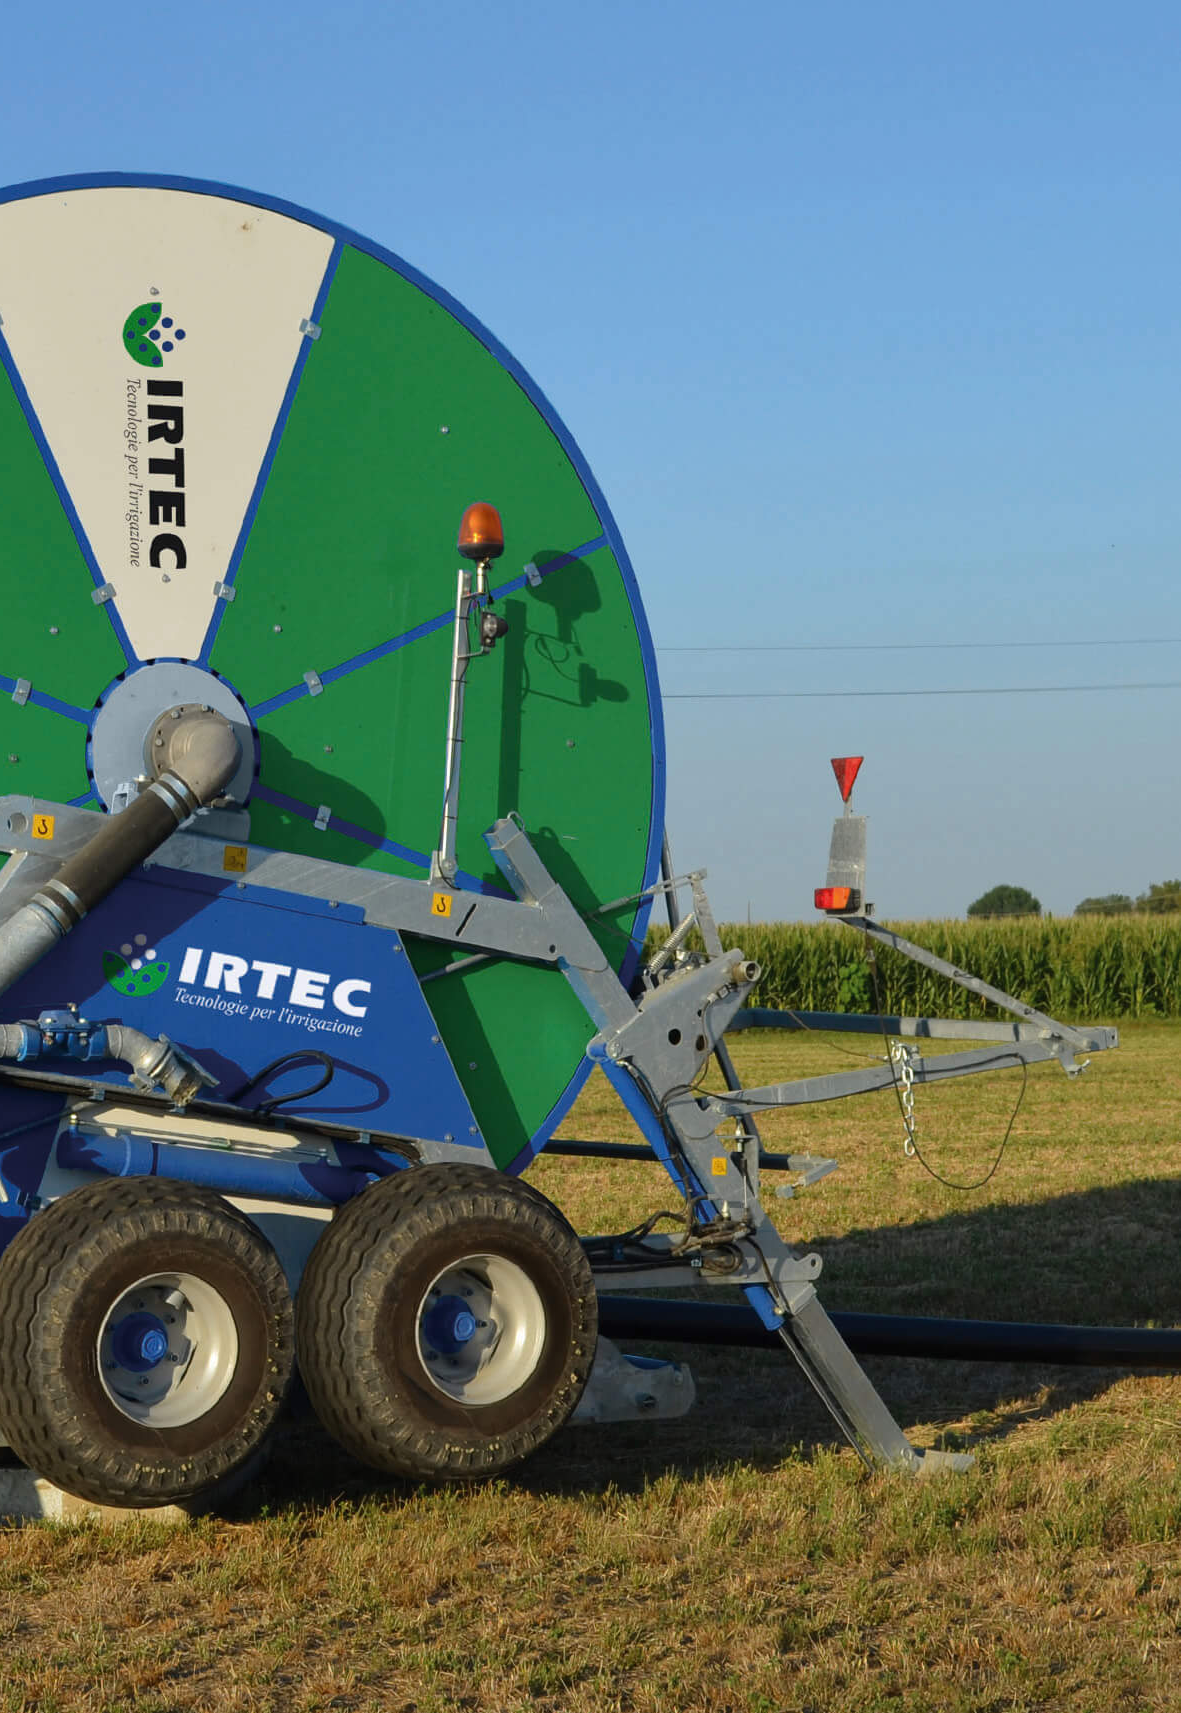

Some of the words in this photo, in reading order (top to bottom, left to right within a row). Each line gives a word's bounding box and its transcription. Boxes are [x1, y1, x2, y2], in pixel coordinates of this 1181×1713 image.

[124, 378, 141, 452] Tecnologie
[124, 453, 139, 480] per
[146, 379, 187, 570] IRTEC
[125, 483, 144, 568] l'irrigazione
[174, 986, 249, 1017] Tecnologie
[249, 1006, 276, 1021] per
[277, 1007, 363, 1037] l'irrigazione
[178, 946, 372, 1018] IRTEC
